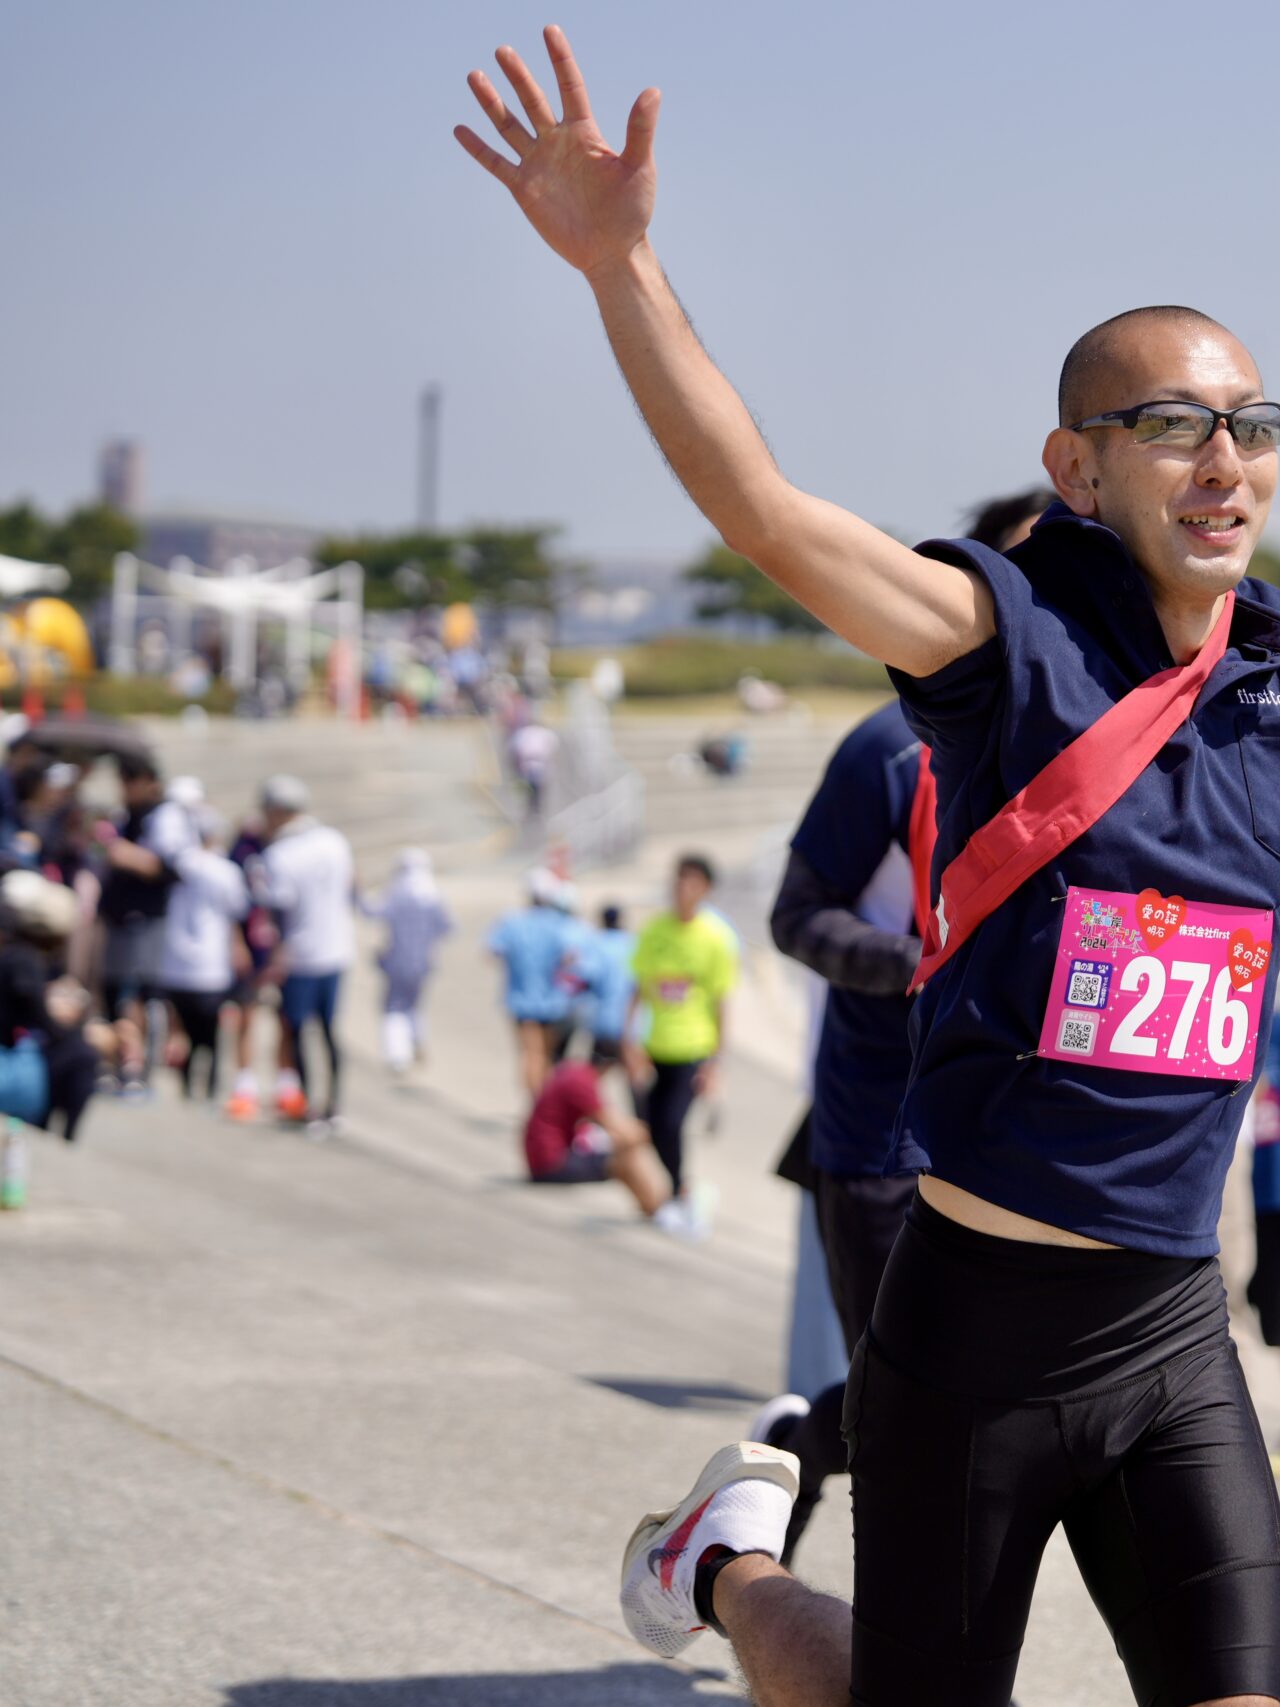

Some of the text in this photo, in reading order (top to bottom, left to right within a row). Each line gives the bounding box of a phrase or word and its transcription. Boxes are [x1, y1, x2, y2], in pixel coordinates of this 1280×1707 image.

[1142, 904, 1179, 925] 愛の証
[1147, 925, 1166, 938] 明石
[1179, 925, 1231, 940] 株式会社first
[1080, 936, 1107, 949] 2024
[1233, 943, 1266, 969] 愛の証
[1234, 964, 1252, 979] 明石
[1109, 956, 1253, 1066] 276
